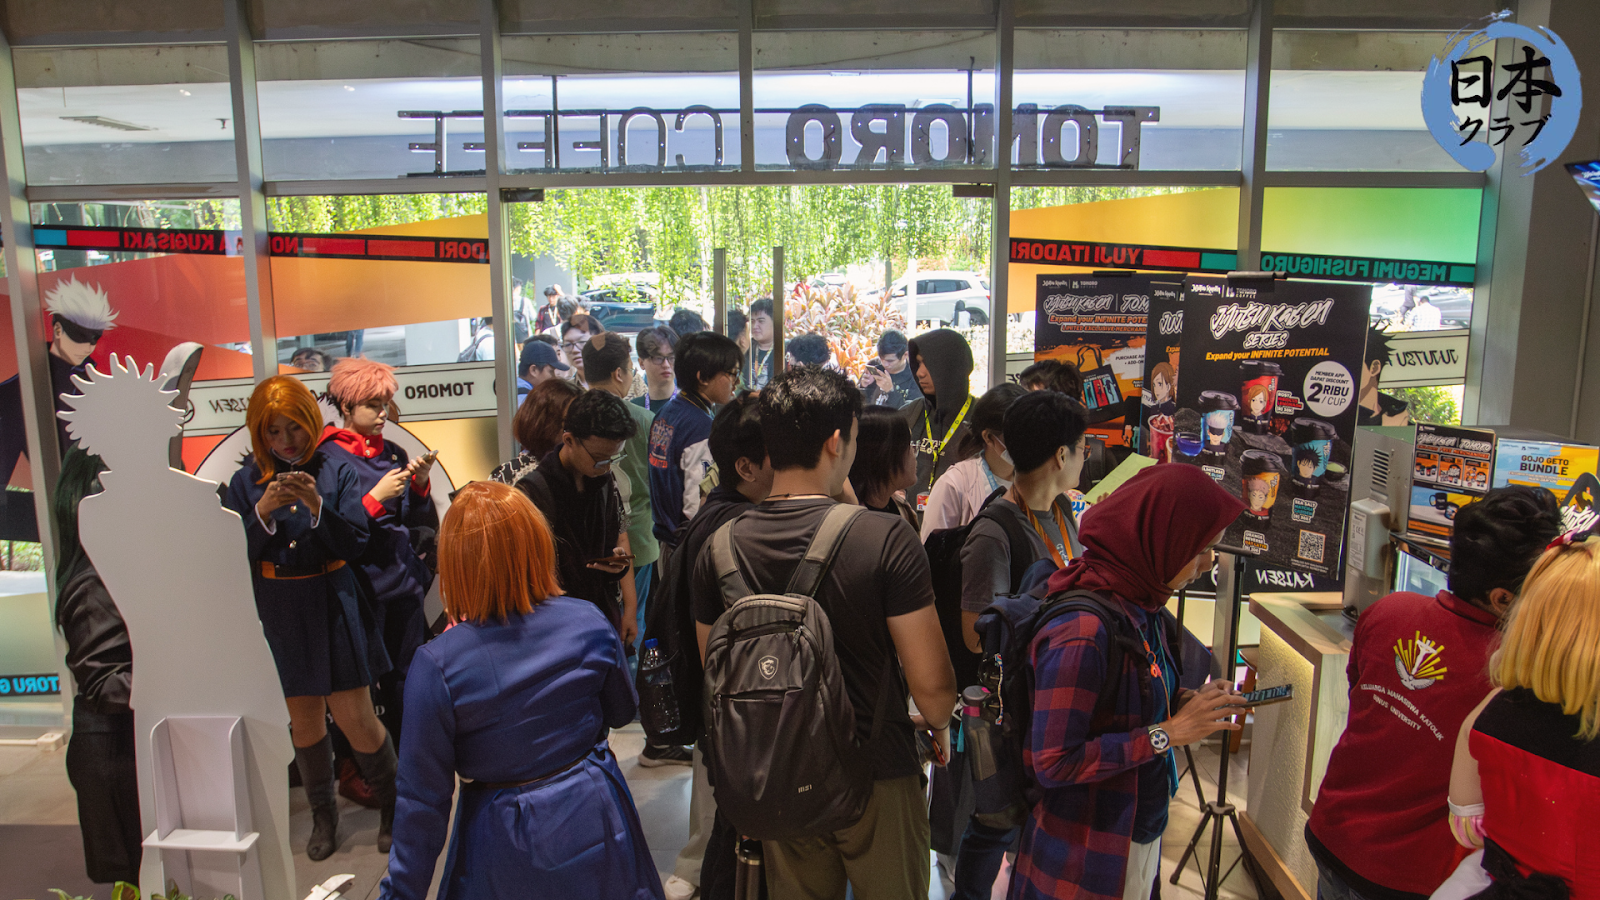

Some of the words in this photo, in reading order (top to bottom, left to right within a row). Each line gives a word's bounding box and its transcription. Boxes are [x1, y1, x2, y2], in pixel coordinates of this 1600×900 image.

[1050, 314, 1077, 324] Expand
[1077, 316, 1094, 324] your
[1095, 315, 1126, 323] INFINITE
[1245, 332, 1289, 348] SERIES
[1205, 352, 1233, 361] Expand
[1233, 352, 1250, 361] your
[1250, 350, 1283, 358] INFINITE
[1284, 348, 1329, 358] POTENTIAL
[1307, 382, 1323, 403] 2
[1323, 384, 1350, 396] RIBU
[1521, 454, 1544, 463] GOJO
[1546, 458, 1569, 466] GETO
[1520, 462, 1569, 476] BUNDLE
[1387, 688, 1420, 716] MAHASISWA
[1420, 714, 1444, 741] KATOLIK
[1390, 705, 1422, 730] UNIVERSITY
